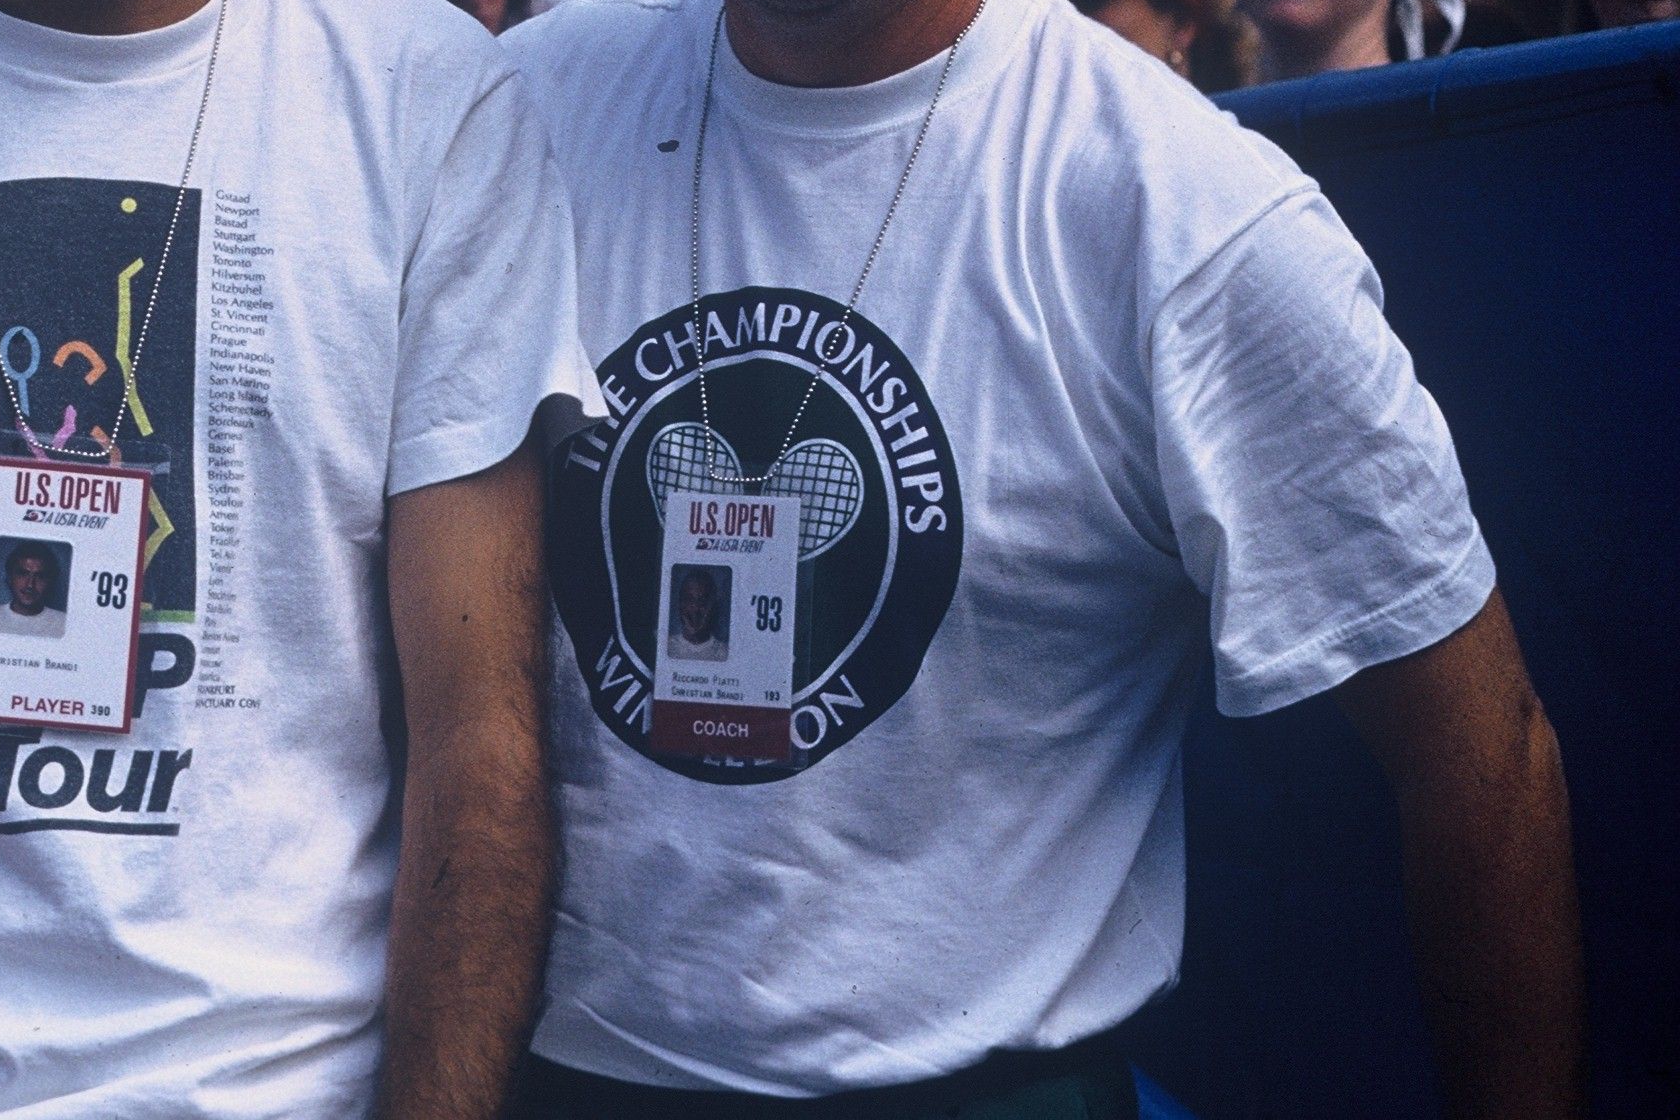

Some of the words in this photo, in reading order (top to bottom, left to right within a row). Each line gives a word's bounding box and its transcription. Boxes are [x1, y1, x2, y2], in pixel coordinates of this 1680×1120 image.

[216, 189, 250, 203] Gstaad
[215, 202, 260, 217] Newport
[215, 215, 248, 229] Bastad
[214, 228, 256, 243] Stuttgart
[213, 241, 274, 256] Washington
[212, 254, 252, 268] Toronto
[212, 268, 266, 281] Hilversum
[211, 281, 262, 295] Kitzbuhel
[211, 295, 229, 306] Los
[231, 298, 274, 311] Angeles
[227, 310, 268, 324] Vincent
[210, 321, 266, 336] Cincinnati
[210, 333, 248, 347] Prague
[210, 348, 275, 365] Indianapolis
[210, 361, 235, 373] New
[239, 363, 271, 377] Haven
[209, 374, 229, 385] San
[231, 377, 271, 391] Marino
[209, 389, 235, 402] Long
[238, 391, 268, 404] Island
[208, 402, 274, 420] Schenectady
[634, 301, 948, 535] CHAMPIONSHIPS
[208, 442, 235, 454] Basel
[15, 471, 56, 508] U.S.
[59, 475, 121, 515] OPEN
[44, 511, 52, 524] A
[54, 512, 76, 526] USTA
[77, 514, 110, 529] EVENT
[689, 501, 722, 535] U.S.
[724, 502, 776, 538] OPEN
[90, 570, 129, 610] '93
[750, 594, 783, 632] '93
[764, 690, 781, 701] 193
[11, 695, 85, 716] PLAYER
[90, 704, 111, 717] 390
[693, 720, 750, 738] COACH
